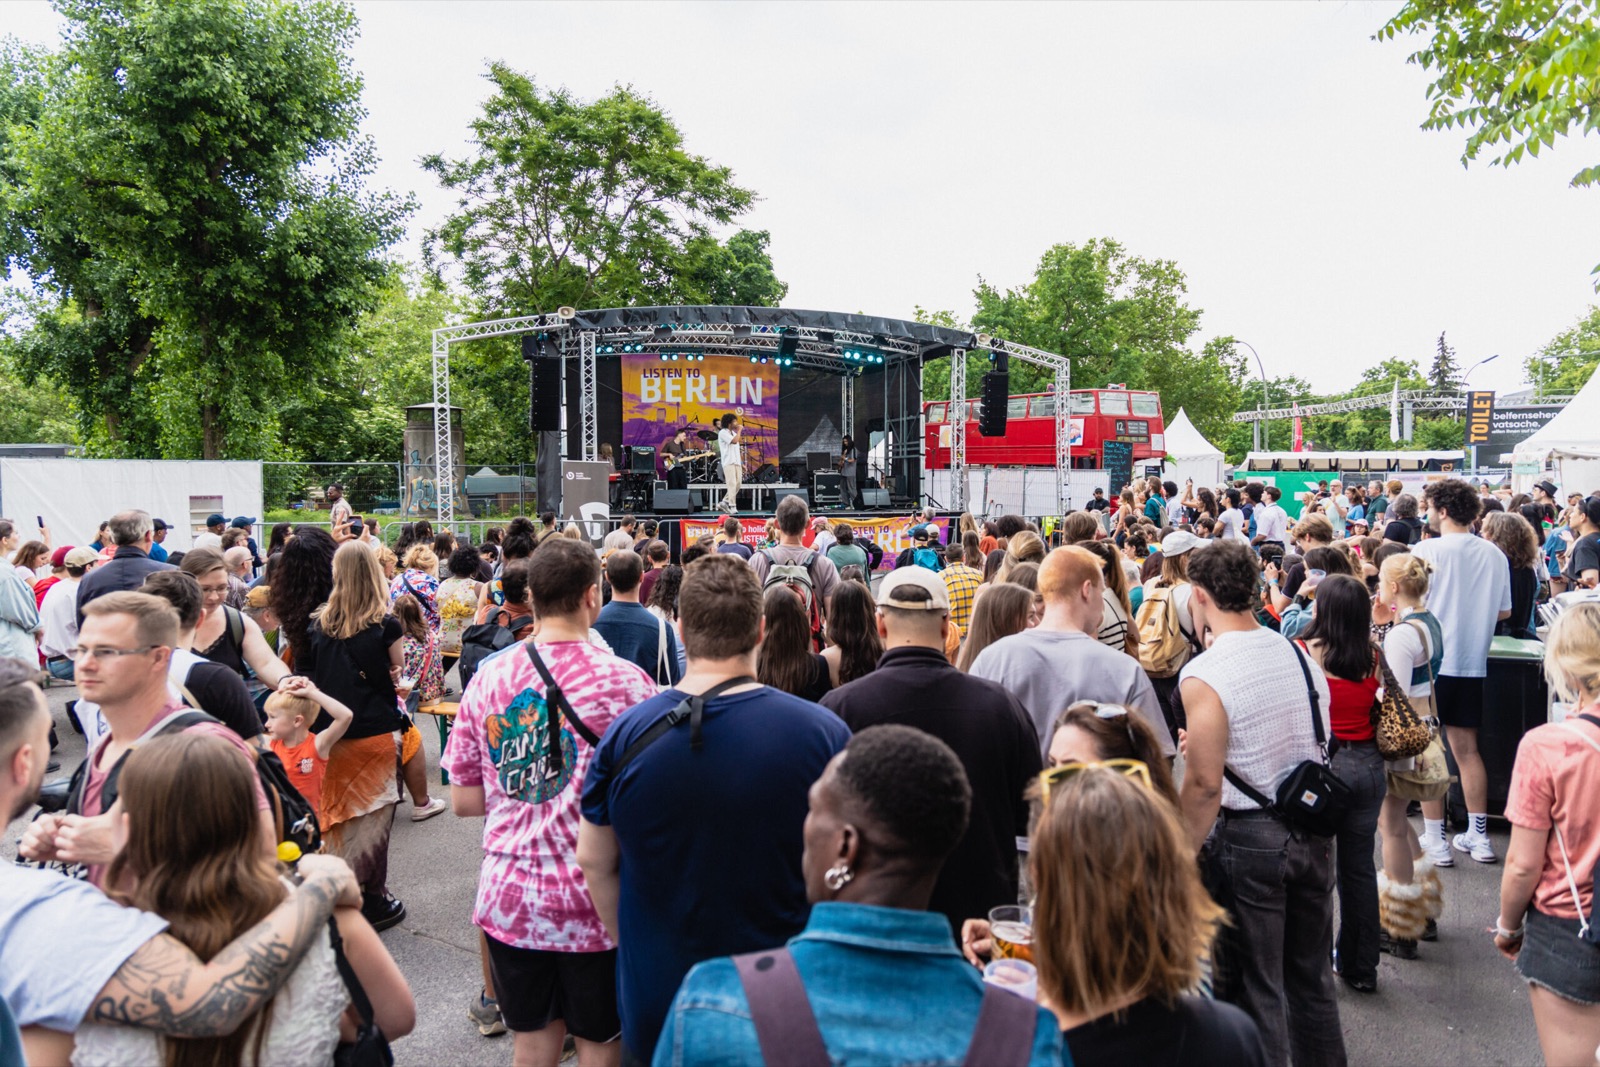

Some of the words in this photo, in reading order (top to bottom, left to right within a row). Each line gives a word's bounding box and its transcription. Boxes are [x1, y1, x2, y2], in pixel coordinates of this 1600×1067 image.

[643, 368, 682, 378] LISTEN
[686, 368, 700, 378] TO
[640, 374, 763, 405] BERLIN
[1470, 391, 1492, 443] TOILET
[878, 525, 889, 534] TO
